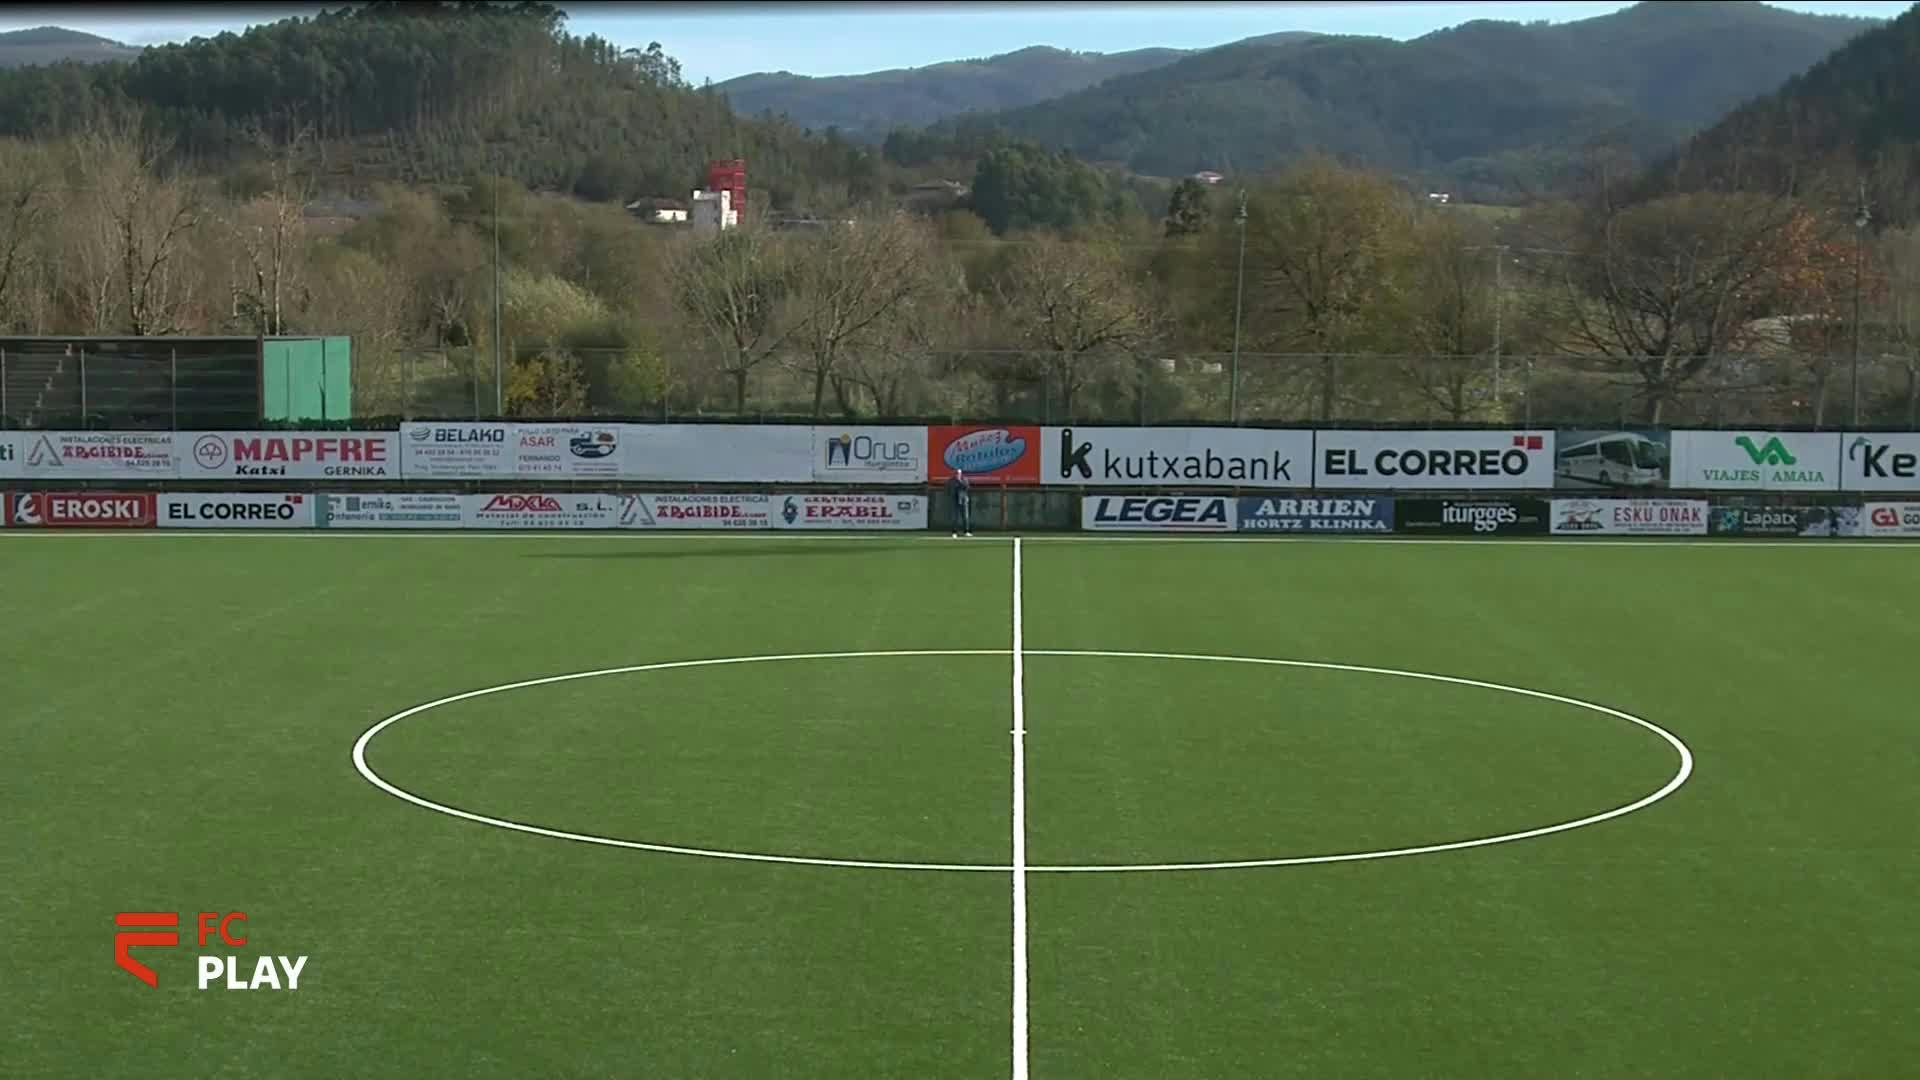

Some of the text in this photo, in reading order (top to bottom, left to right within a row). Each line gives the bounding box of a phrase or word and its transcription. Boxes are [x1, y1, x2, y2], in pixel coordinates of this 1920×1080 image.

[435, 428, 504, 442] BELAKO
[520, 437, 555, 447] ASAR
[233, 438, 386, 461] MAPFRE
[854, 436, 910, 460] Orue
[235, 465, 386, 476] Katxi GERNIKA
[1104, 448, 1291, 480] kutxabank
[1325, 449, 1528, 476] EL CORREO
[1703, 469, 1825, 482] VIAJES AMAIA
[53, 500, 139, 518] EROSKI
[169, 503, 294, 520] EL CORREO
[1094, 498, 1227, 522] LEGEA
[1255, 500, 1377, 516] ARRIEN
[1613, 507, 1701, 522] ESKU ONAK
[1244, 519, 1386, 529] HORTZ KLINIKA
